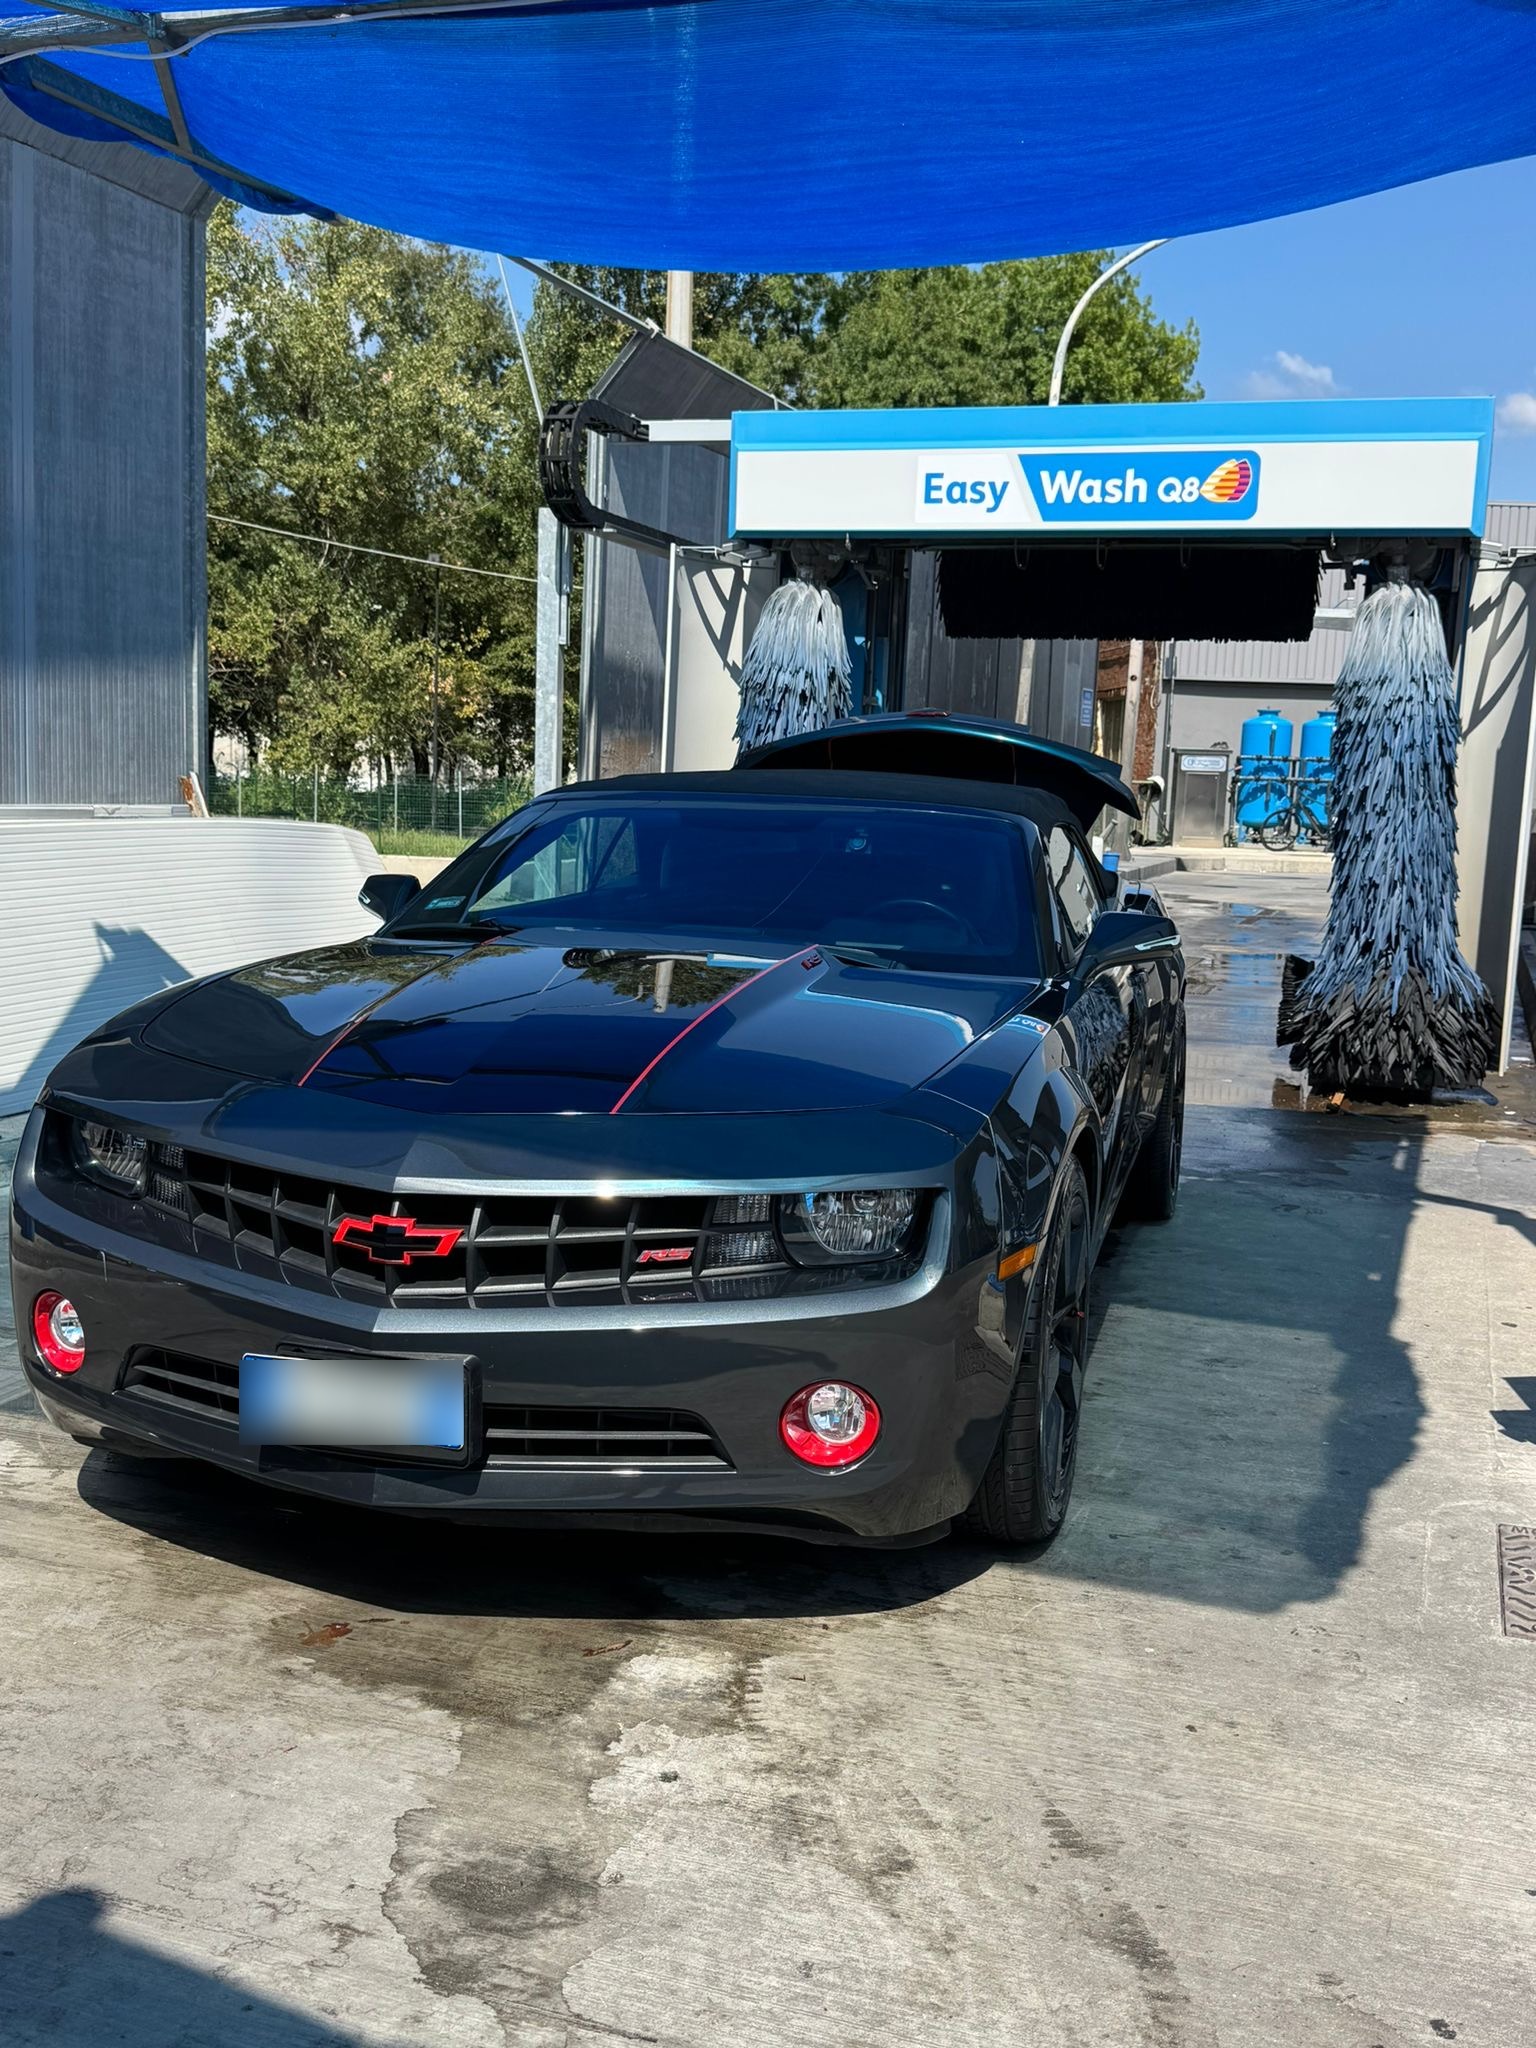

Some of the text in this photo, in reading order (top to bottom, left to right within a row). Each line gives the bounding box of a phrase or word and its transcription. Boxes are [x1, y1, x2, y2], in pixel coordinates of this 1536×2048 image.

[923, 468, 1201, 513] Easy Wash Q8
[636, 1246, 695, 1263] RS
